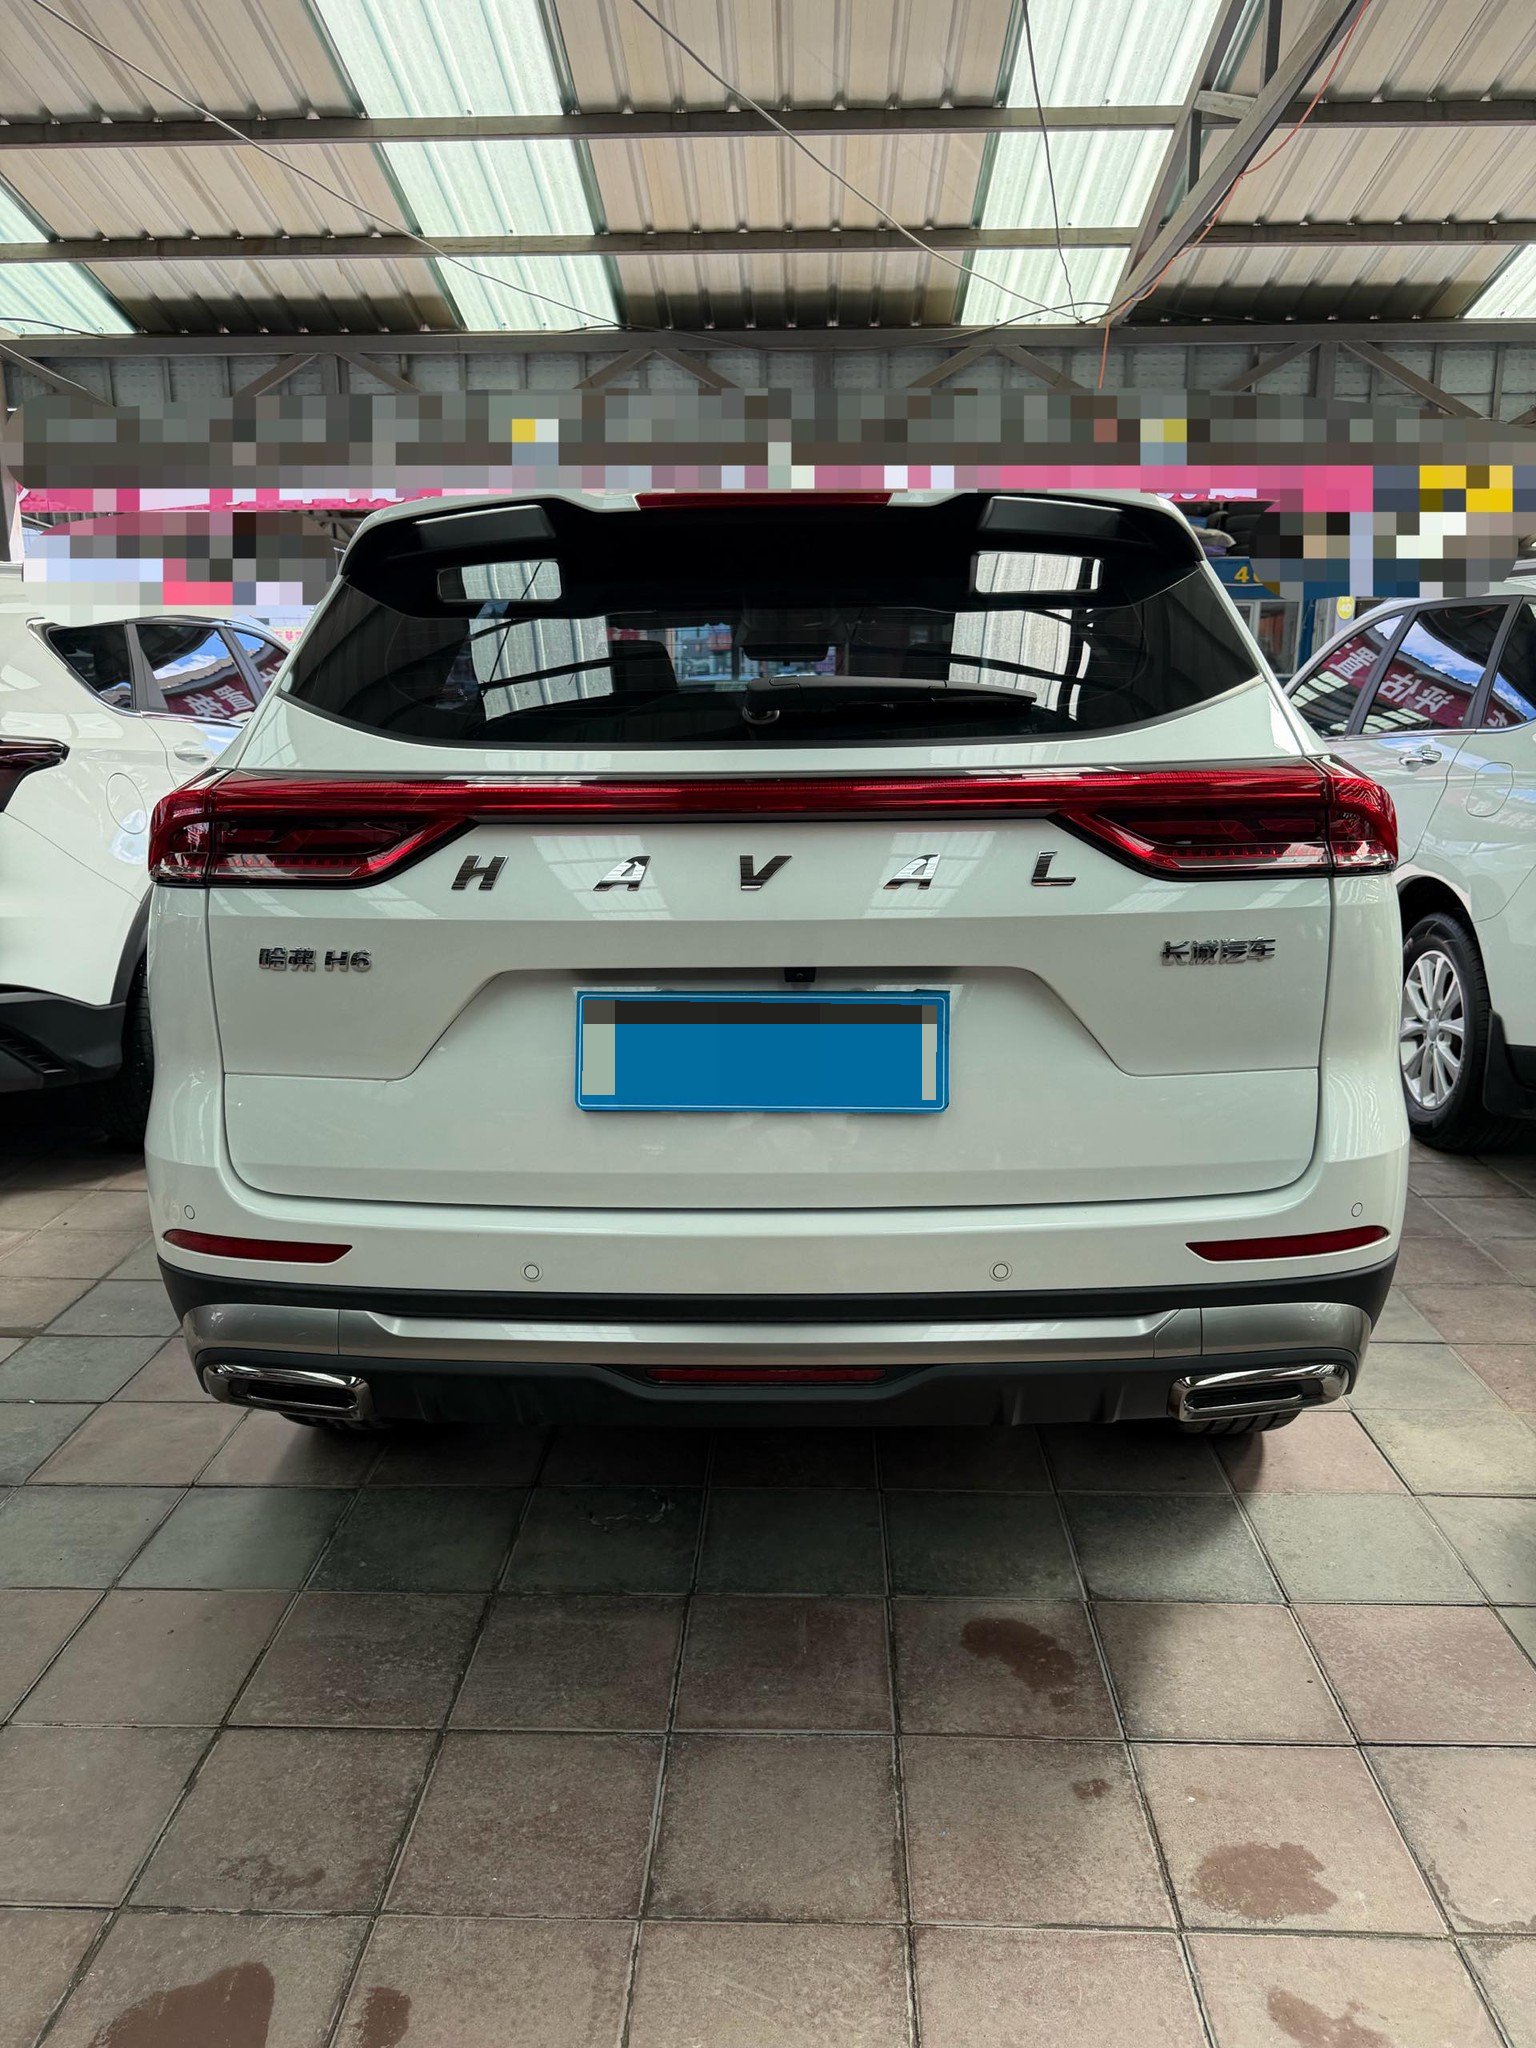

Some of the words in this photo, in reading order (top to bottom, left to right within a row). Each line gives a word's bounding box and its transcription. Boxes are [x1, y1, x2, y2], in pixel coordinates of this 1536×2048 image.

[450, 850, 1078, 893] HAVAL
[324, 949, 372, 973] H6
[1160, 936, 1277, 967] 长城汽车
